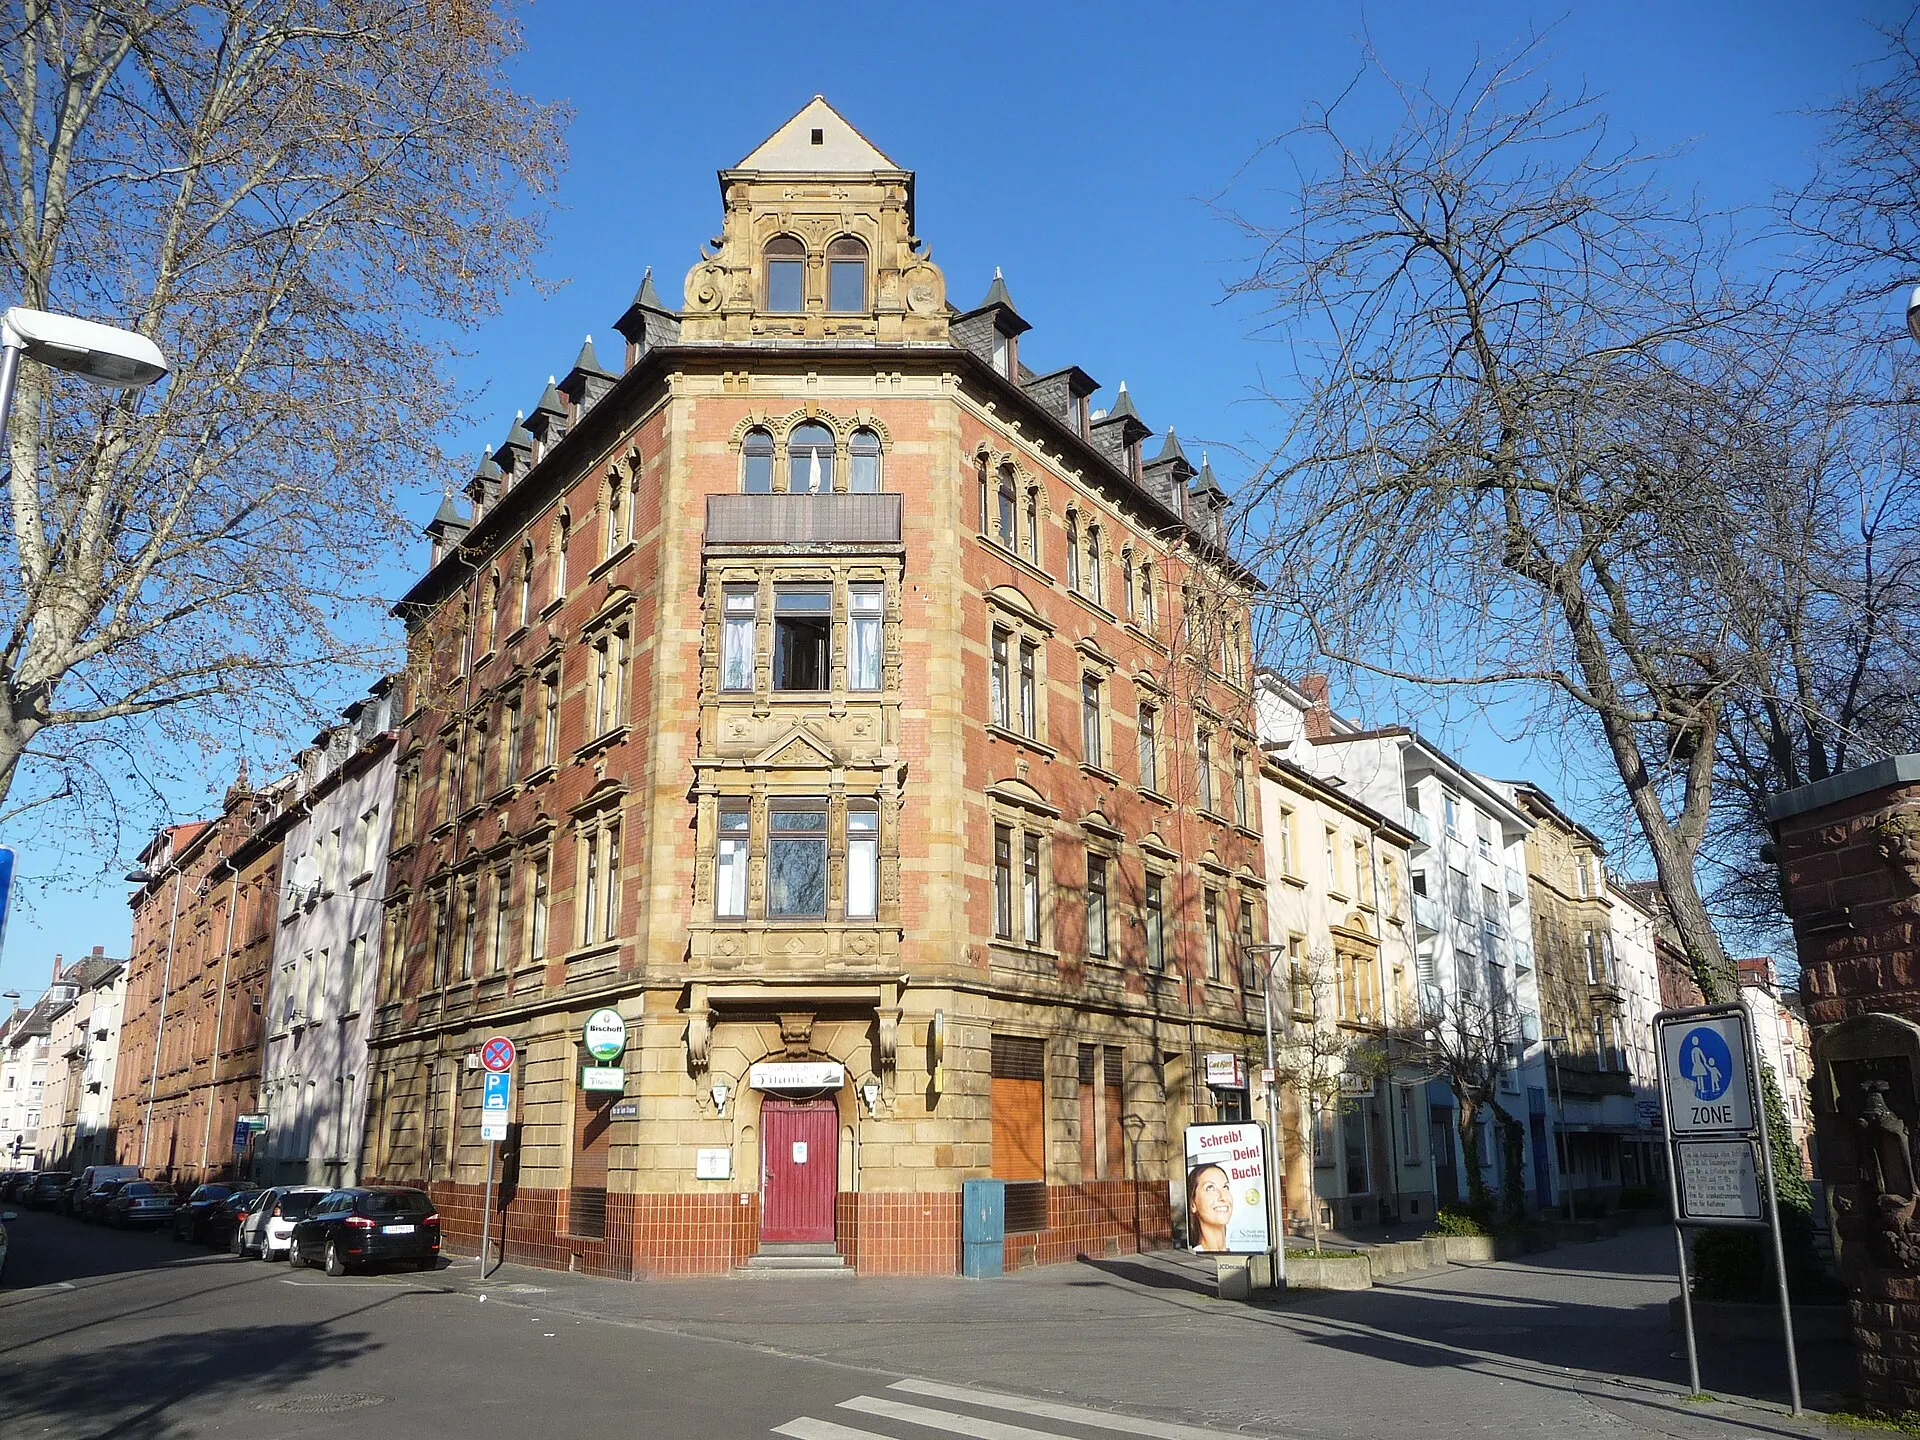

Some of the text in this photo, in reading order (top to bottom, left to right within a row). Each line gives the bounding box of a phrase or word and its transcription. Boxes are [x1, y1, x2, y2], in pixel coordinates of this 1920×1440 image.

[590, 1025, 622, 1033] Bischoff
[488, 1075, 501, 1091] P
[751, 1073, 809, 1086] Titanic
[1691, 1105, 1733, 1125] ZONE
[1199, 1129, 1243, 1148] Schreib!
[1233, 1145, 1260, 1161] Dein!
[1231, 1164, 1262, 1180] Buch!
